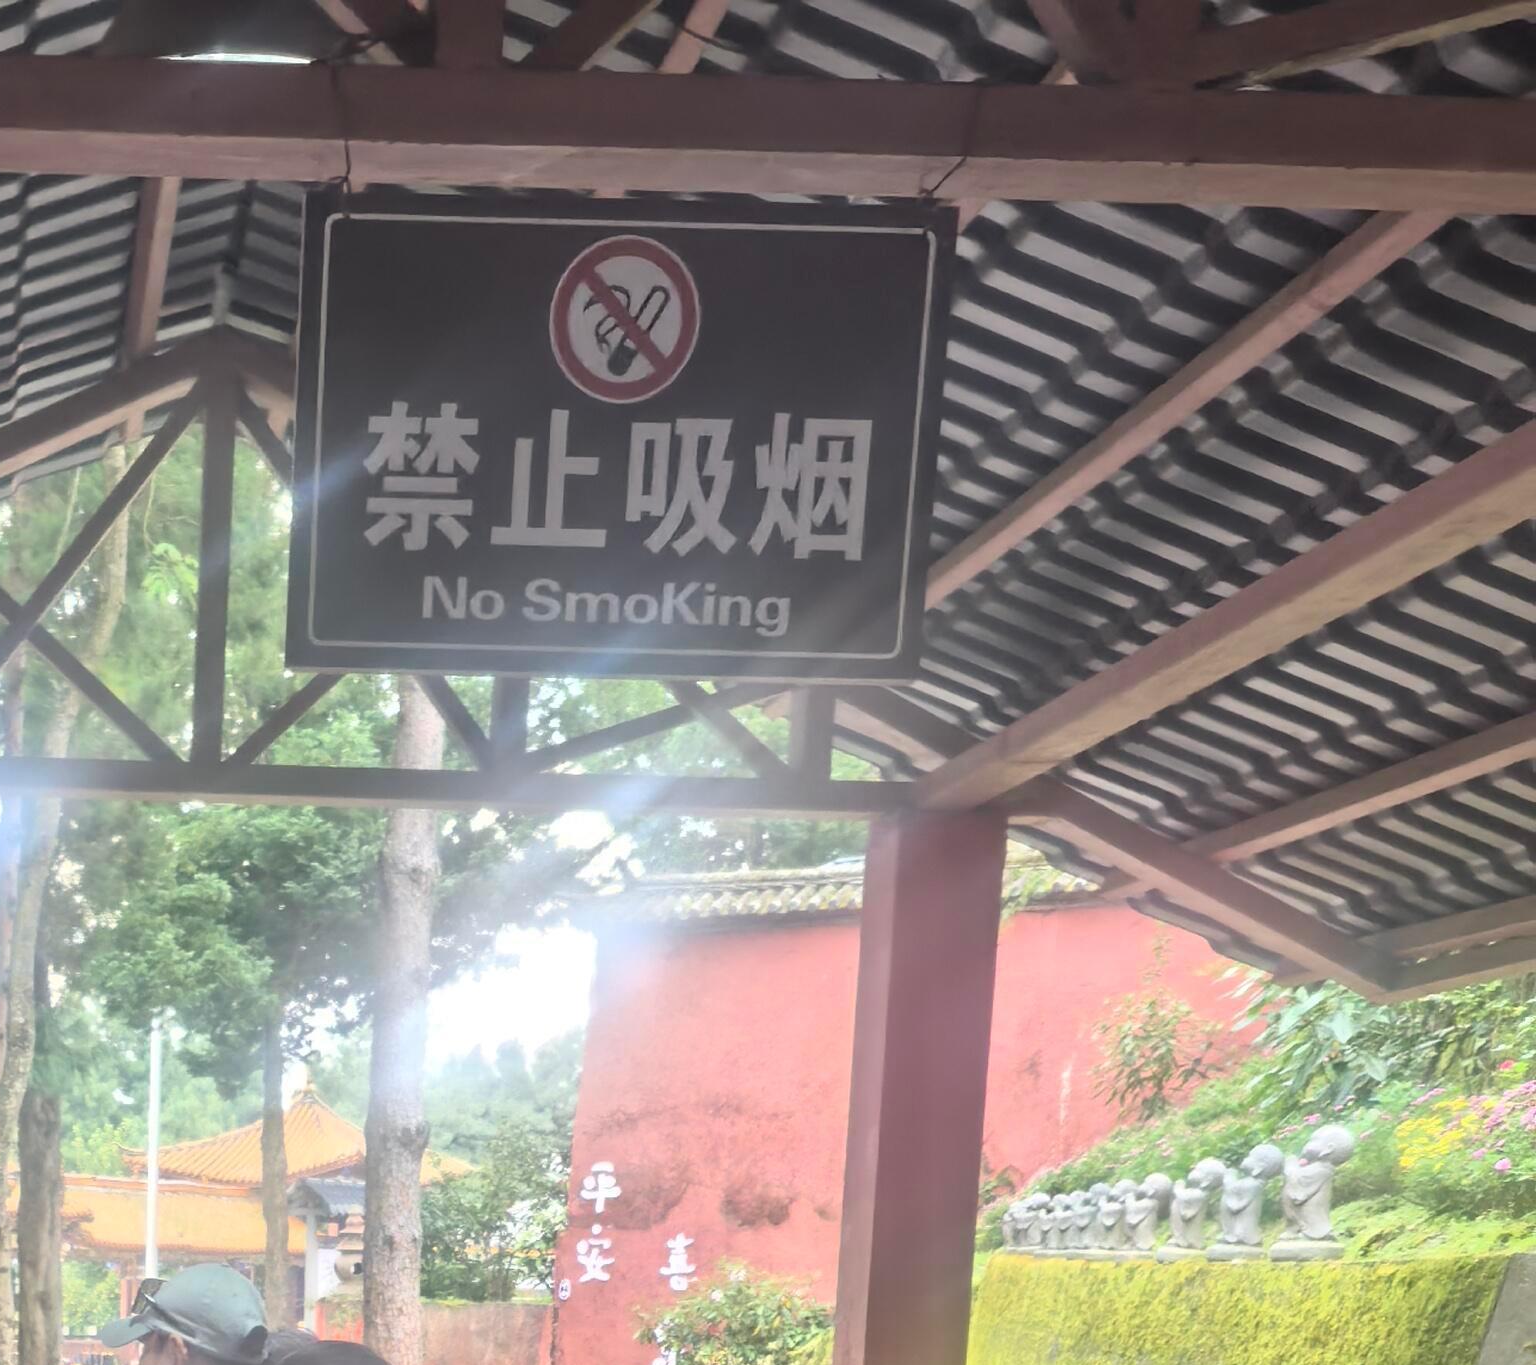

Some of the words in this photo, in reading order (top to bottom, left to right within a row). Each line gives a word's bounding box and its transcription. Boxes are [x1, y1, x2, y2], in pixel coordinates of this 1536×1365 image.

[362, 401, 873, 561] 禁止吸烟
[421, 575, 505, 621] No
[522, 578, 792, 638] SmoKing
[576, 1161, 622, 1283] 平安
